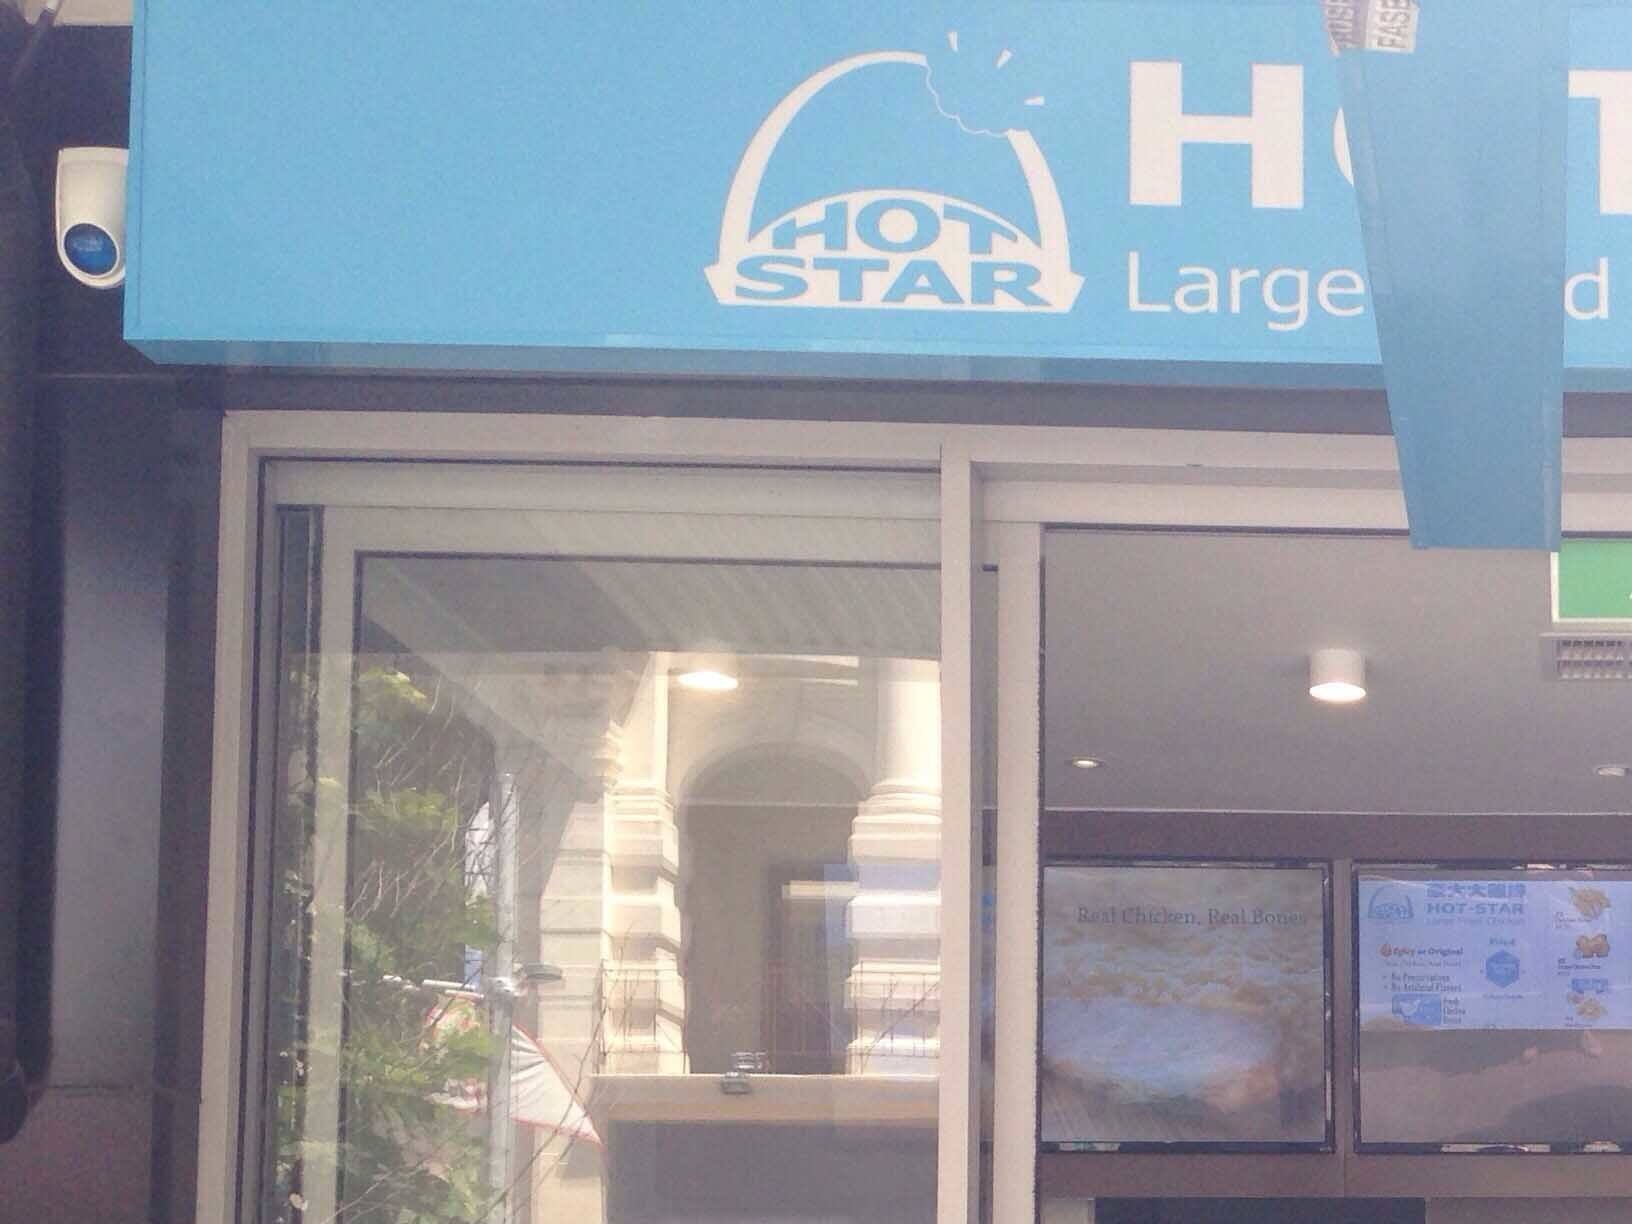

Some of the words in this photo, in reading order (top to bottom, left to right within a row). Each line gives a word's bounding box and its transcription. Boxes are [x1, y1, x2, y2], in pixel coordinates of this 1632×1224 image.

[768, 198, 1022, 256] HOT
[735, 258, 1053, 308] STAR
[1128, 253, 1365, 331] Large
[1077, 906, 1116, 925] Real
[1207, 907, 1246, 926] Real
[1426, 903, 1525, 915] HOT-STAR
